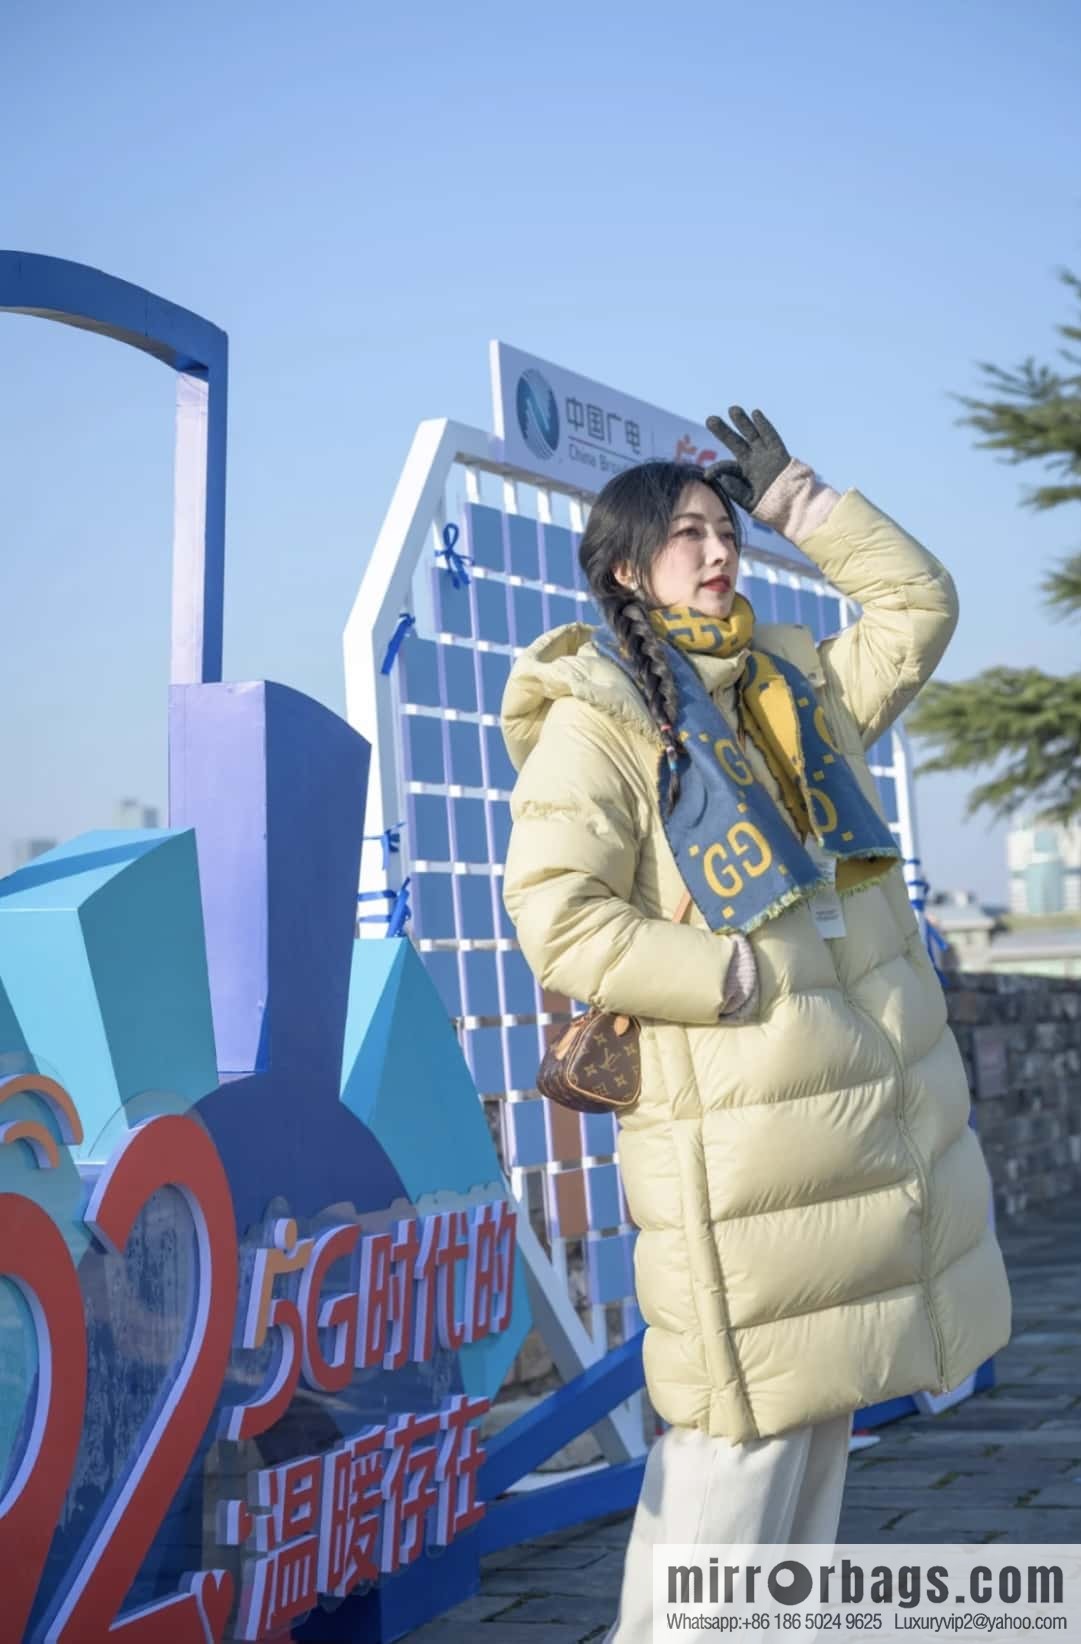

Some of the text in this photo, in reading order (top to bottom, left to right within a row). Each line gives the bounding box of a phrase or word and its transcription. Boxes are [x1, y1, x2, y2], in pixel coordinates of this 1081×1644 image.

[566, 397, 641, 455] 中国广电
[228, 1200, 518, 1440] 5G时代的
[224, 1394, 490, 1642] 温暖存在
